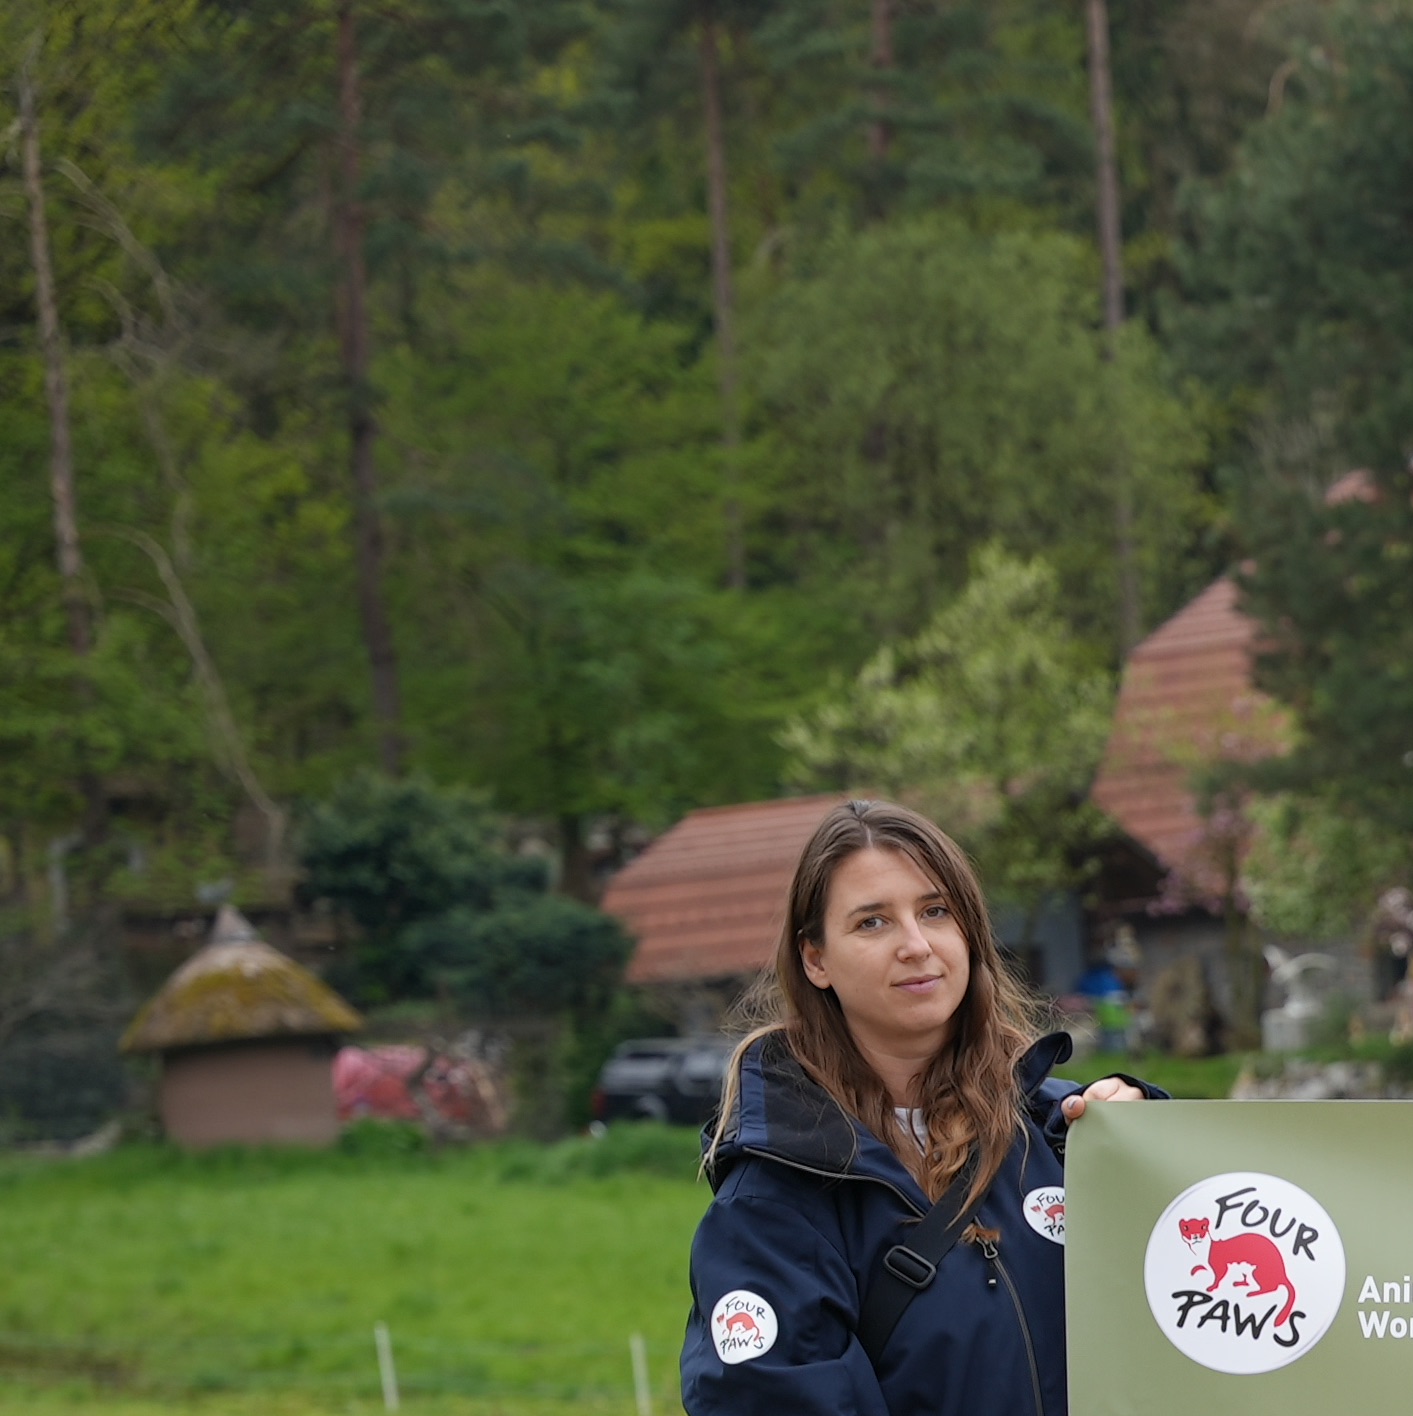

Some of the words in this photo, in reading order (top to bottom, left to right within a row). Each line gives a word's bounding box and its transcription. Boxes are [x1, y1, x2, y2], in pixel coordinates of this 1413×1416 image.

[1214, 1186, 1319, 1261] FOUR
[725, 1296, 766, 1320] FOUR
[1171, 1290, 1306, 1348] PAWS
[719, 1336, 765, 1355] PAWS
